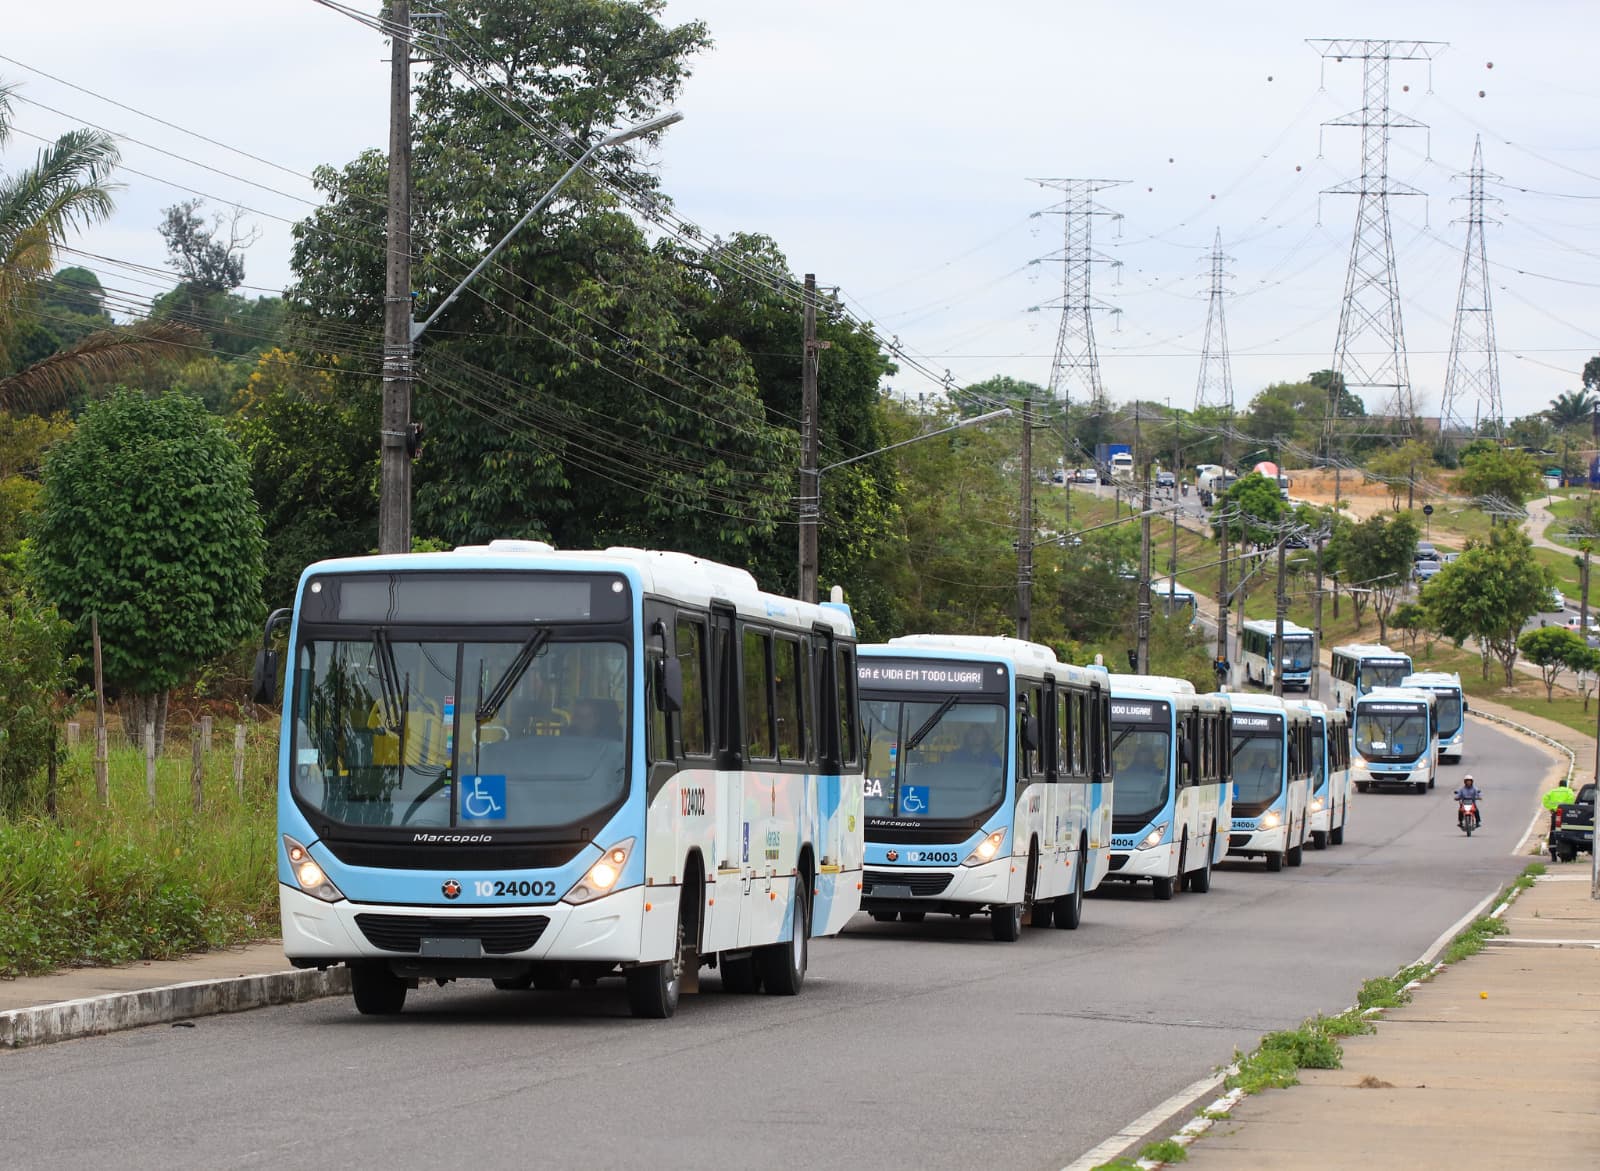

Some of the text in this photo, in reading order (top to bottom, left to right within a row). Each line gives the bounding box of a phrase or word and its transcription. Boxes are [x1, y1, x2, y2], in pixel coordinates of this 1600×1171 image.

[857, 668, 872, 679] GA
[882, 669, 903, 680] VIDA
[905, 670, 918, 680] EM
[921, 670, 945, 681] TODO
[948, 671, 981, 683] LUGAR!
[681, 788, 705, 816] 1024002
[870, 819, 921, 827] Marcopolo
[413, 833, 493, 843] Marcopolo
[907, 851, 958, 862] 1024003
[474, 880, 556, 897] 1024002
